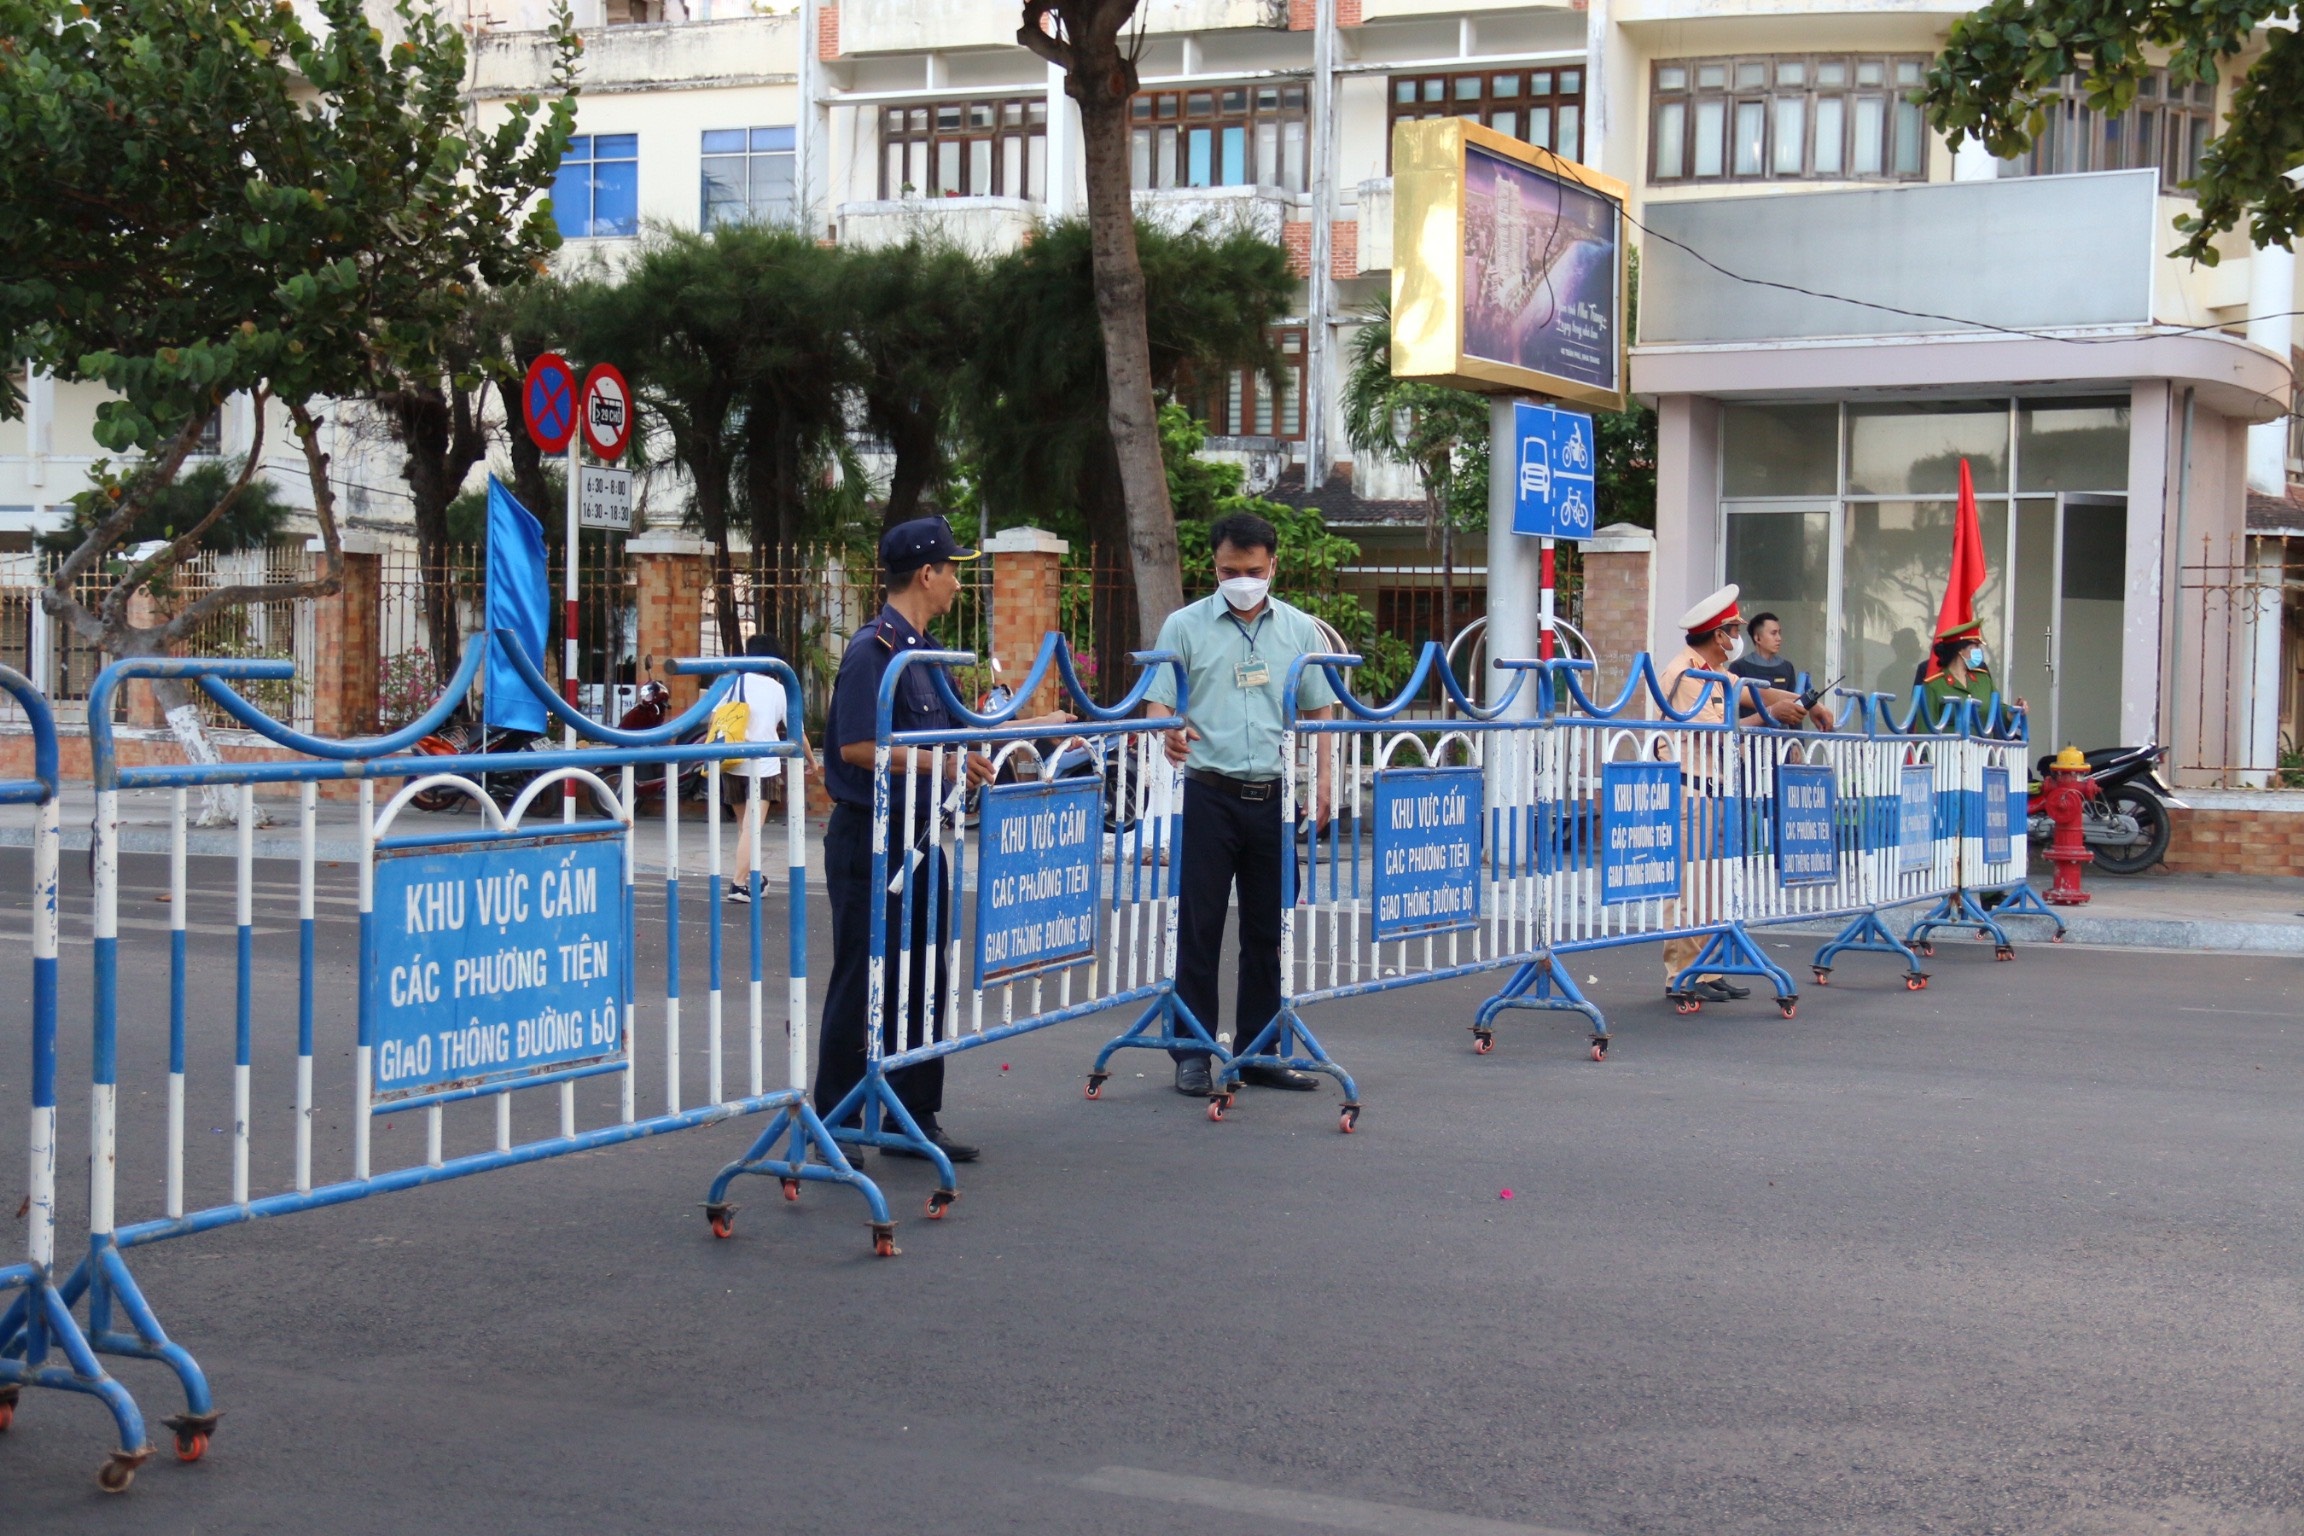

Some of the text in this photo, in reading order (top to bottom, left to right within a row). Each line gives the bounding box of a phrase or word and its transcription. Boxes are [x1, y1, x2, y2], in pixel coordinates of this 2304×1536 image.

[587, 477, 603, 493] 6:30
[611, 480, 625, 495] 8:00
[583, 502, 602, 518] 16:30
[610, 505, 628, 521] 18:30
[1391, 784, 1465, 833] KHU VỰC CẤM
[1614, 772, 1670, 816] KHU VỰC CẤM
[1001, 815, 1027, 855] KHU
[1032, 808, 1055, 858] VỰC
[1385, 837, 1470, 876] CÁC PHƯƠNG TIỆN
[1611, 821, 1672, 850] CÁC PHƯƠNG TIỆN
[405, 850, 597, 935] KHU VỰC CẤM
[992, 857, 1089, 909] CÁC PHƯƠNG TIỆN
[1380, 879, 1473, 922] GIAO THÔNG ĐƯỜNG BỘ
[985, 930, 1008, 964] GIAO
[1045, 910, 1077, 950] ĐƯỜNG
[1079, 906, 1091, 948] BỘ
[390, 933, 608, 1007] CÁC PHƯƠNG TIỆN
[439, 1016, 510, 1072] THÔNG
[516, 1005, 583, 1059] ĐƯỜNG
